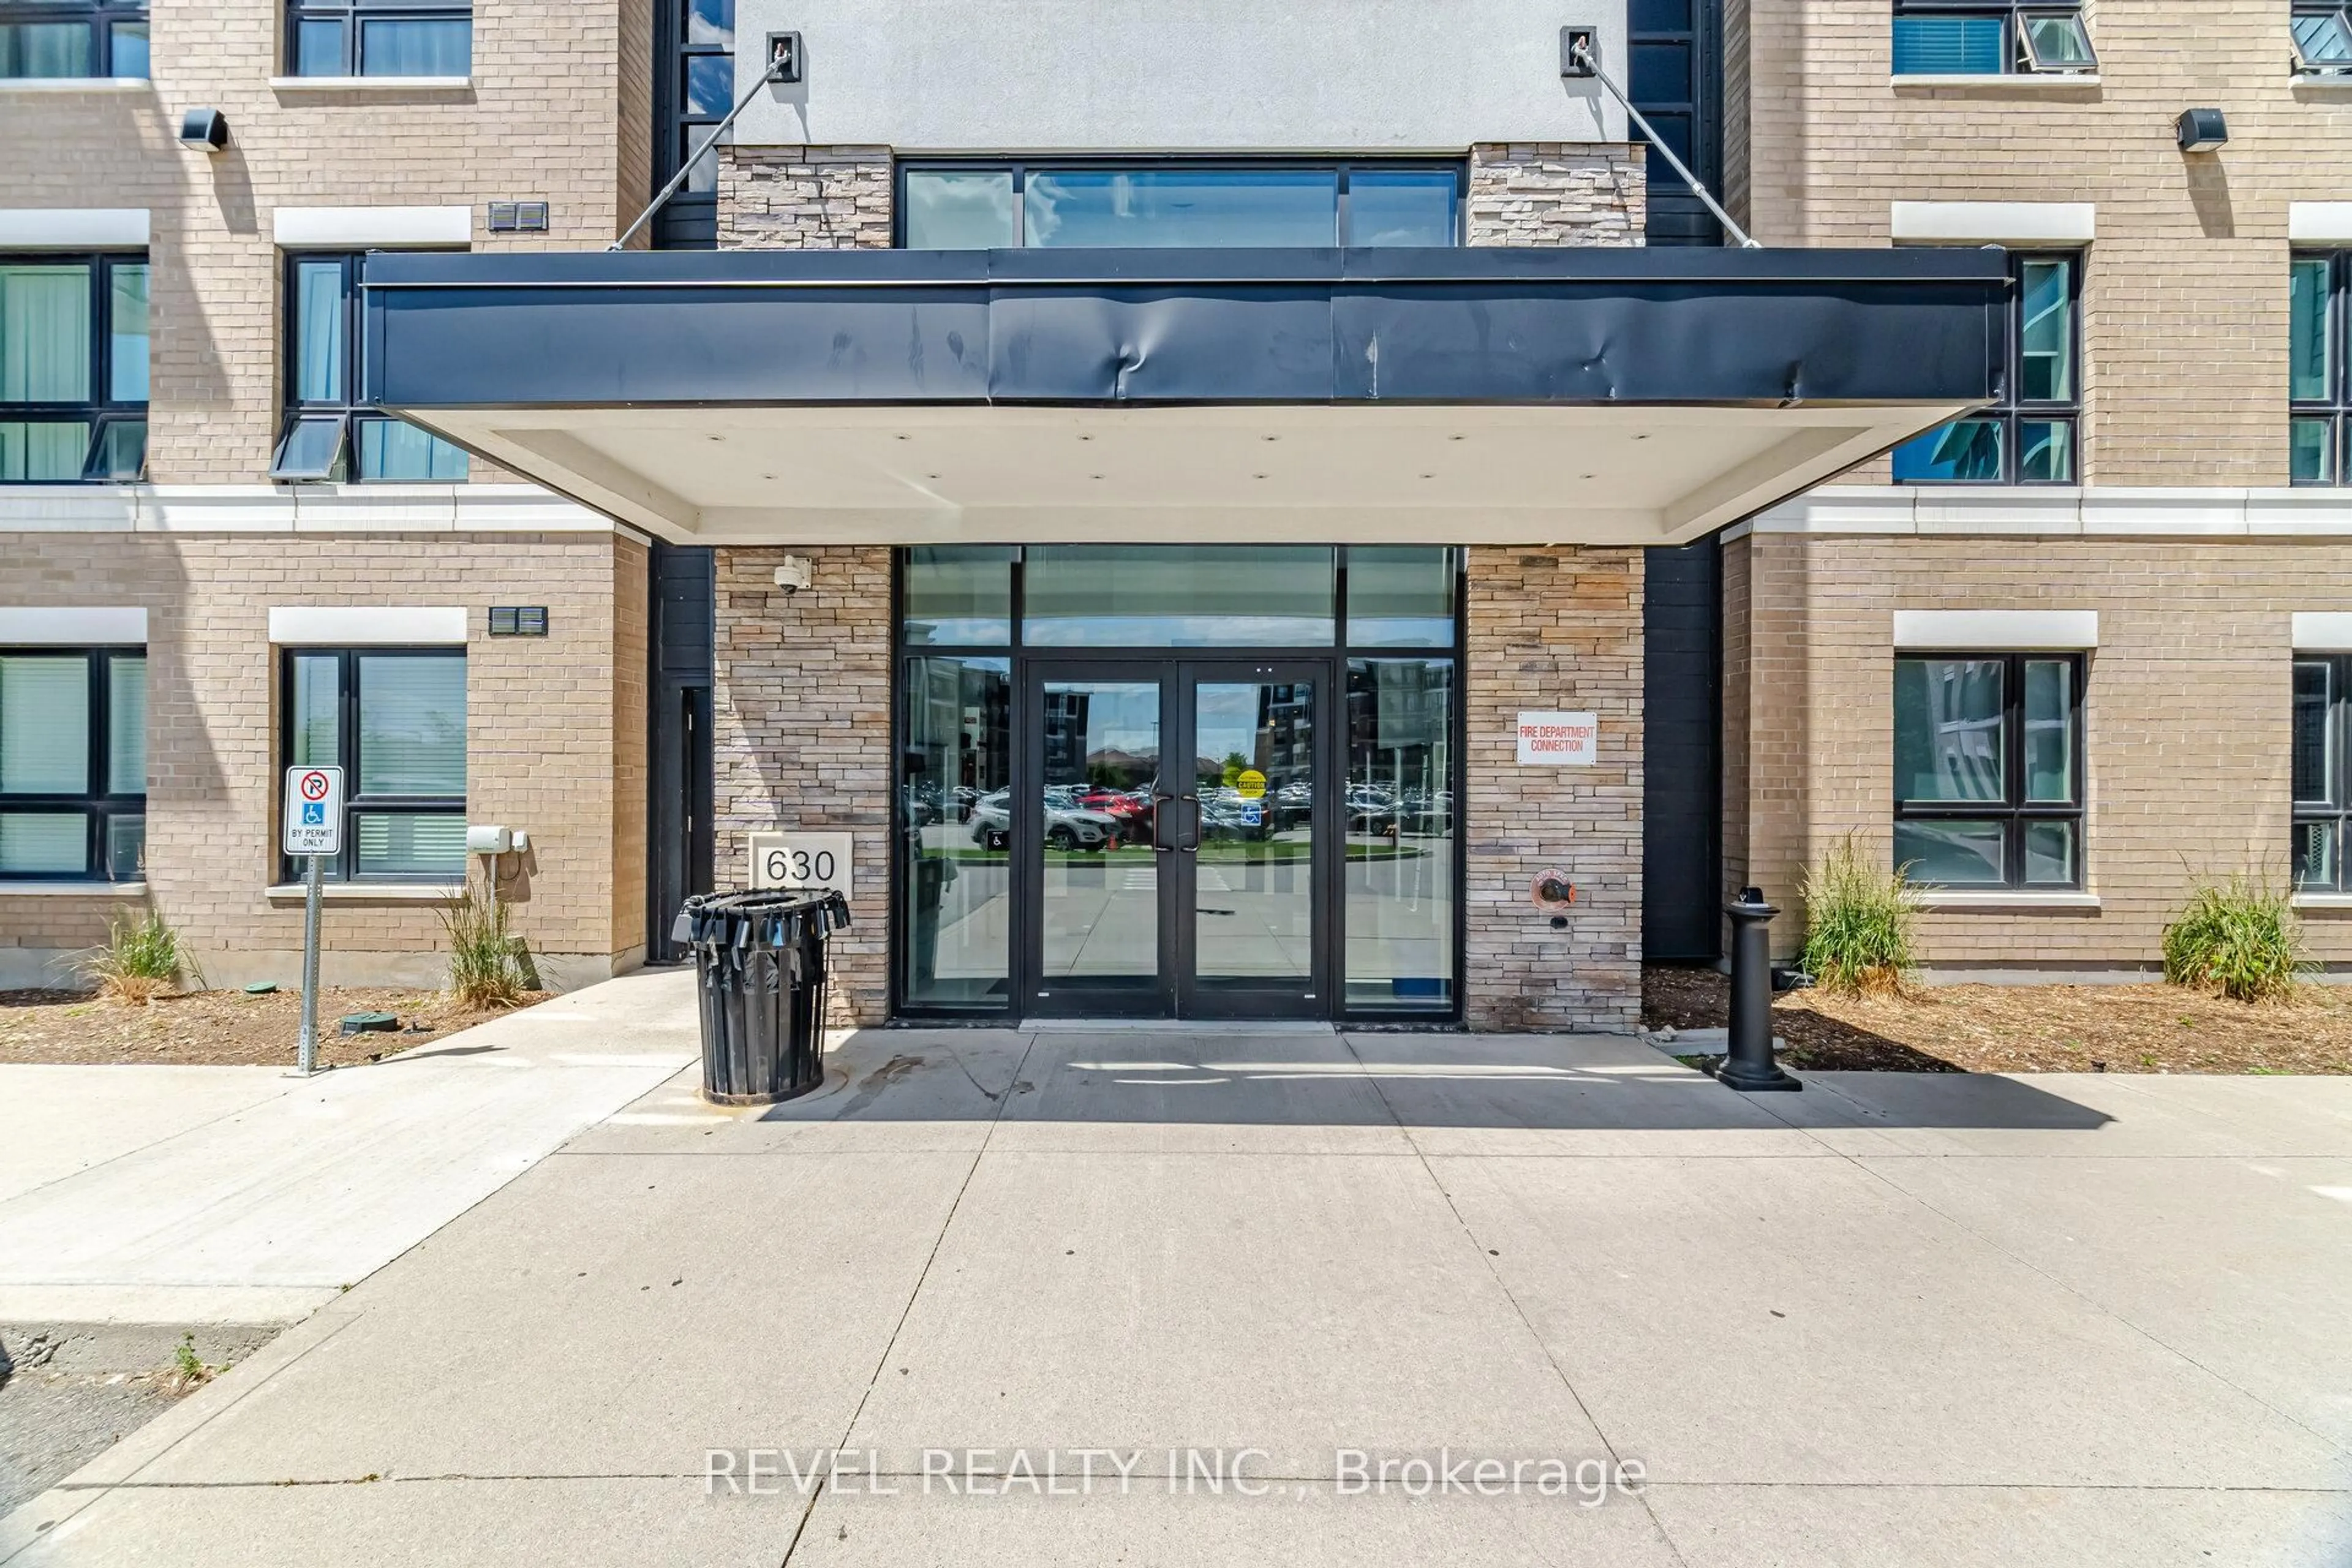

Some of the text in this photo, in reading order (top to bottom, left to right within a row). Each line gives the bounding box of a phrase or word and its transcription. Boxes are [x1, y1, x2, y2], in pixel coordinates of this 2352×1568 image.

[1520, 726, 1594, 739] FIRE DEPARTMENT
[1531, 740, 1583, 752] CONNECTION
[306, 829, 333, 838] PERMIT
[303, 839, 325, 847] ONLY
[767, 850, 835, 881] 630
